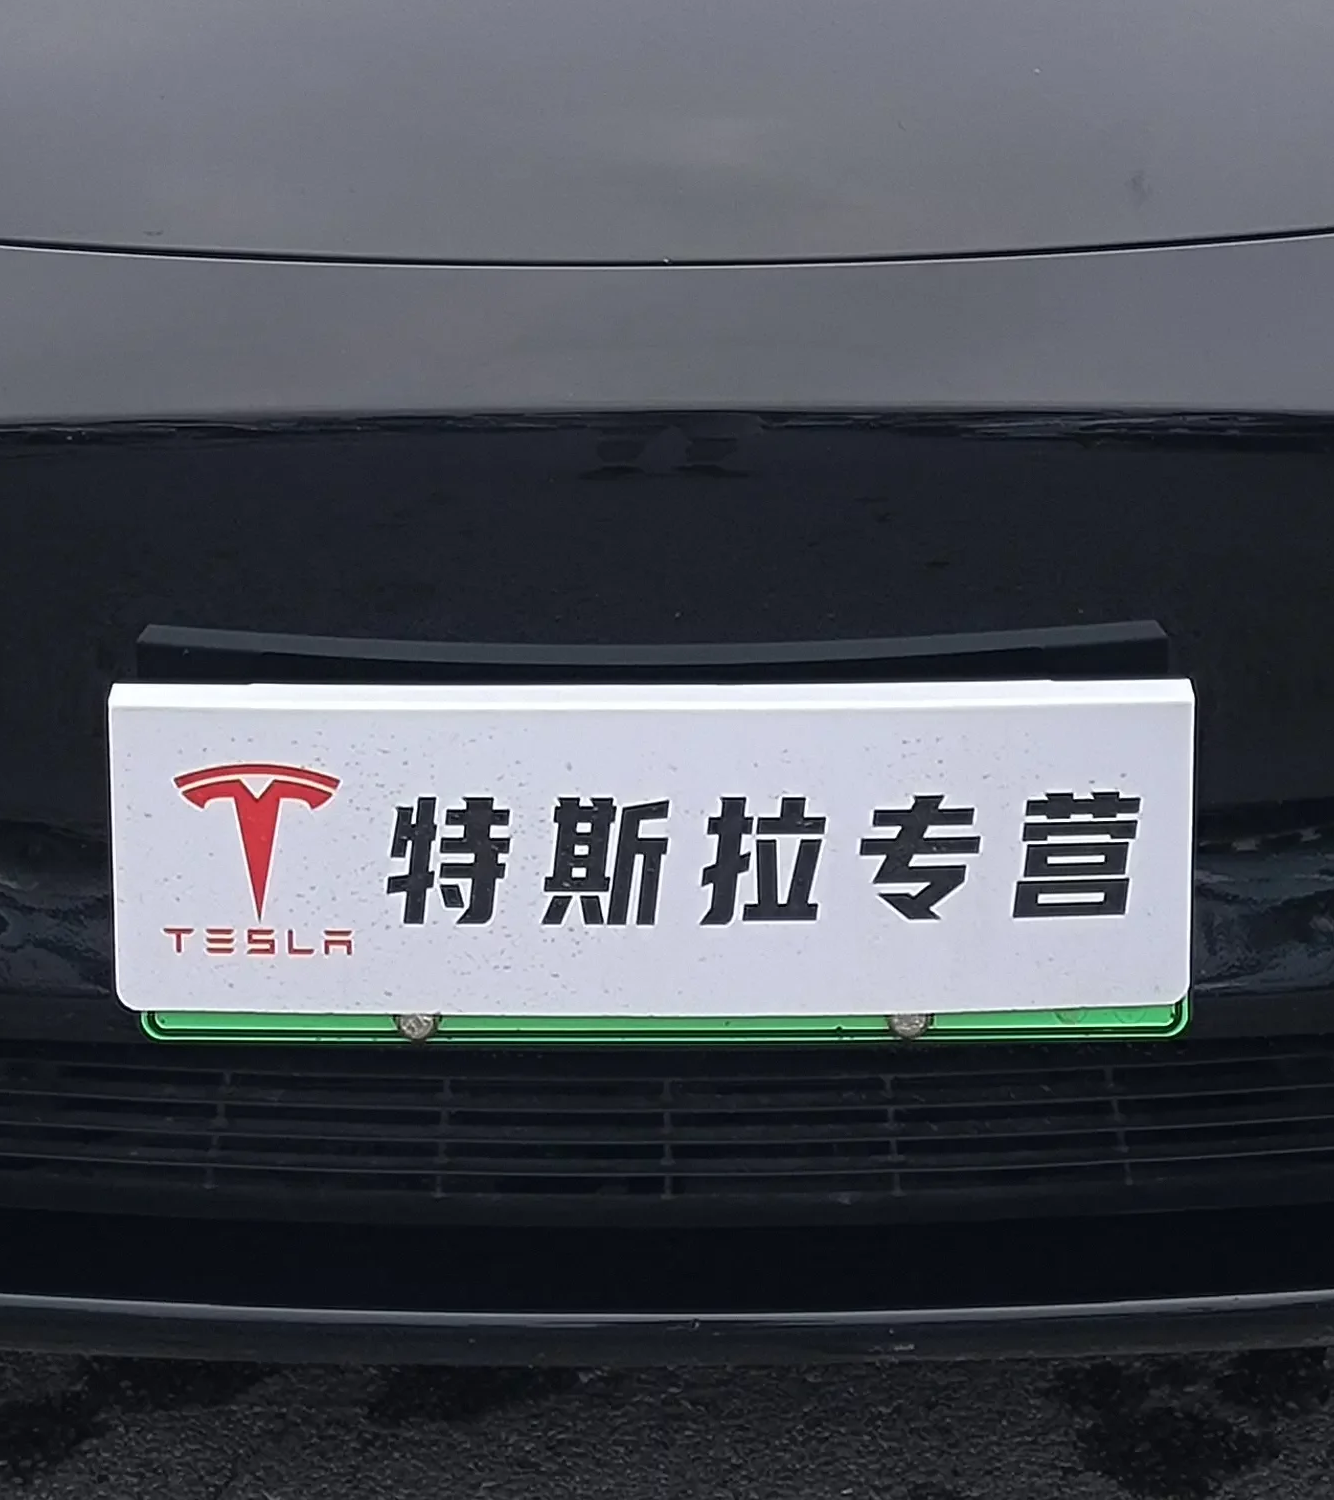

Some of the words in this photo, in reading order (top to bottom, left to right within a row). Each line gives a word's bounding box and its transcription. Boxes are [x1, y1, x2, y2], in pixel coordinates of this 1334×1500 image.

[385, 790, 1142, 927] 特斯拉专营
[162, 927, 353, 956] TESLA
